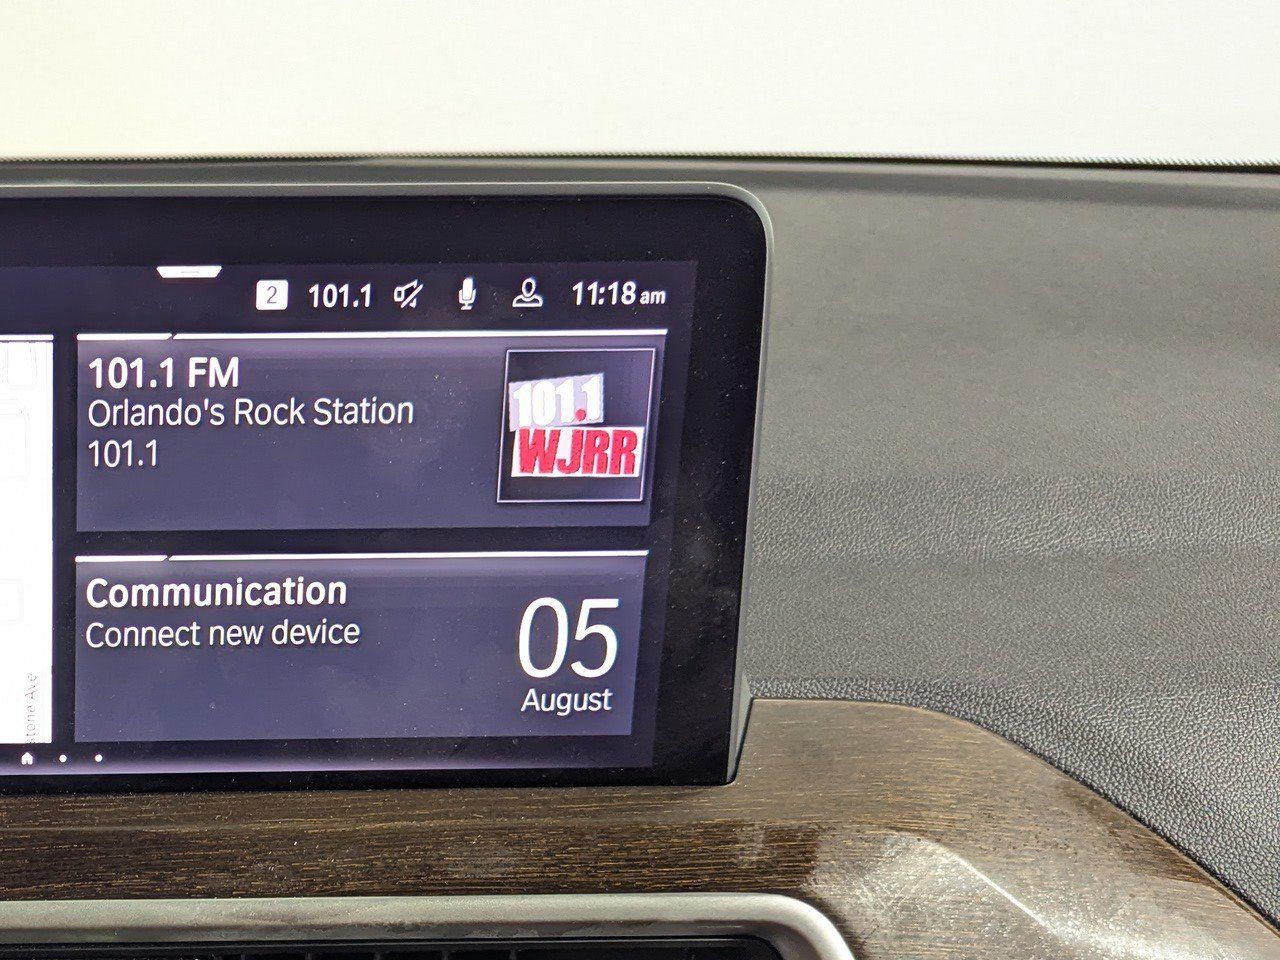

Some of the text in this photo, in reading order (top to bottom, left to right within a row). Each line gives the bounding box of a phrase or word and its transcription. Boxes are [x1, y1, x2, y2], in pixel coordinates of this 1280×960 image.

[267, 284, 371, 308] 2 101.1
[572, 281, 666, 306] 11:18 am
[89, 356, 240, 389] 101.1 FM
[88, 396, 414, 428] Orlando's Rock Station
[511, 374, 603, 427] 101.1
[87, 439, 158, 467] 101.1
[517, 426, 639, 476] WJRR
[85, 576, 348, 609] Communication
[85, 619, 361, 648] Connect new device
[519, 596, 620, 679] 05
[521, 688, 613, 716] August
